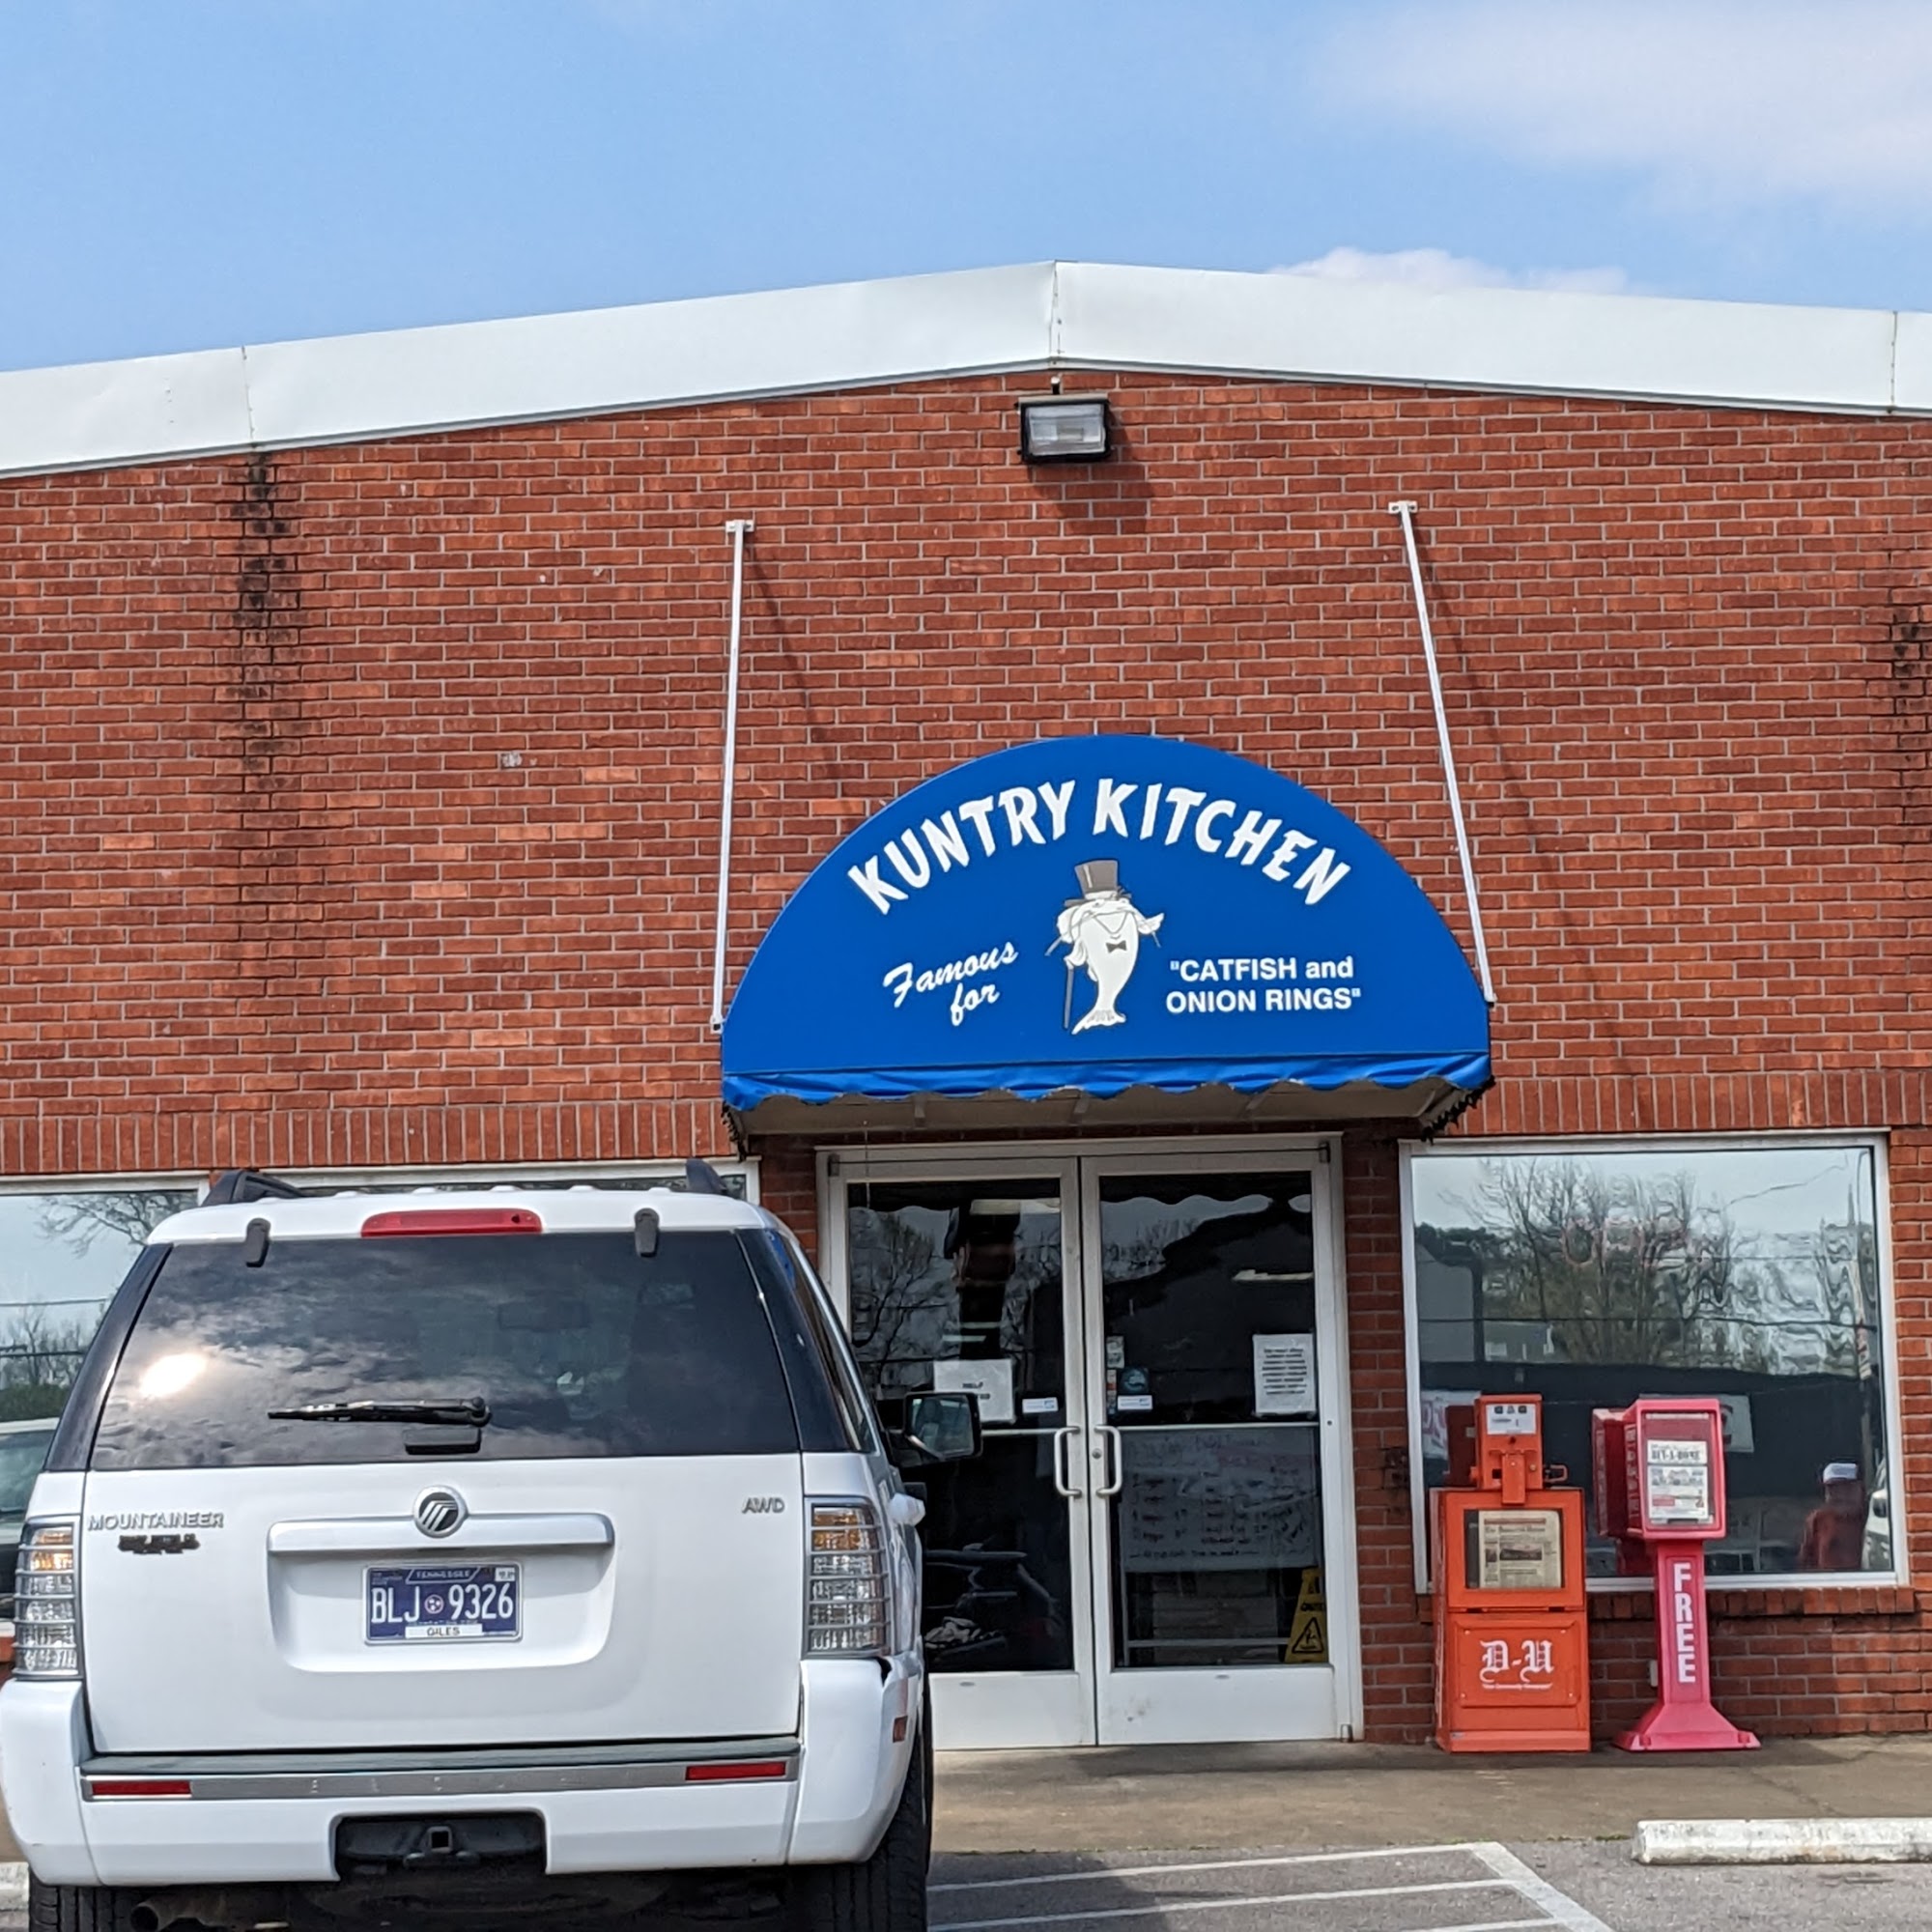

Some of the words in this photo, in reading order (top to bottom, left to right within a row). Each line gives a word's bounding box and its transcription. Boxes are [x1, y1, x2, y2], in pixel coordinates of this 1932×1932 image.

[847, 780, 1075, 915] KUNTRY
[1093, 778, 1351, 905] KITCHEN
[883, 942, 1018, 1008] Famous
[1305, 956, 1353, 979] and
[950, 983, 1000, 1027] for
[1166, 989, 1257, 1013] ONION
[87, 1513, 224, 1531] MOUNTAINEER
[741, 1496, 785, 1515] AWD
[371, 1586, 420, 1624] BLJ
[448, 1582, 514, 1620] 9326
[1674, 1562, 1696, 1683] FREE
